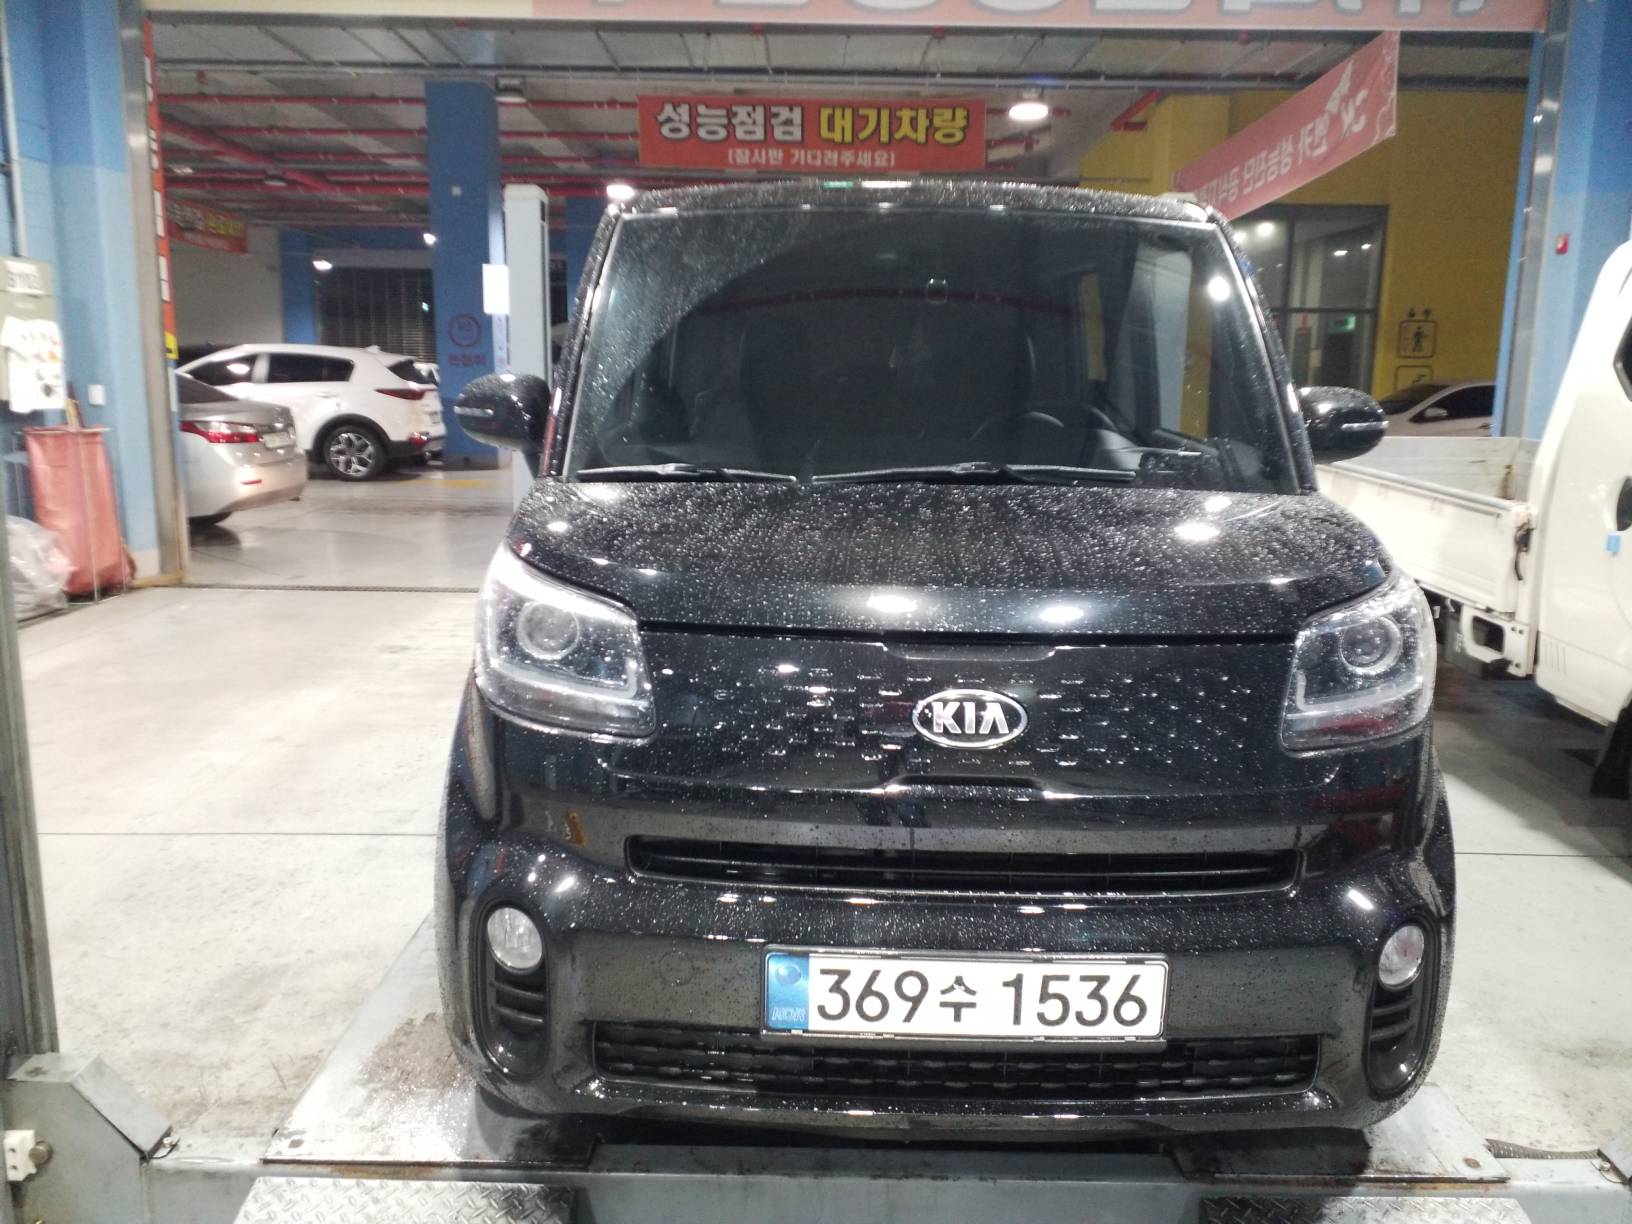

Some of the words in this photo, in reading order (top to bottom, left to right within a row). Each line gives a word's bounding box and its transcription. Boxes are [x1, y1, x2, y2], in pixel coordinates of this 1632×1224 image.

[656, 101, 804, 143] 성능점검
[818, 105, 970, 145] 대기차량
[931, 701, 1010, 734] KIA
[816, 968, 977, 1024] 369수
[1002, 973, 1148, 1028] 1536
